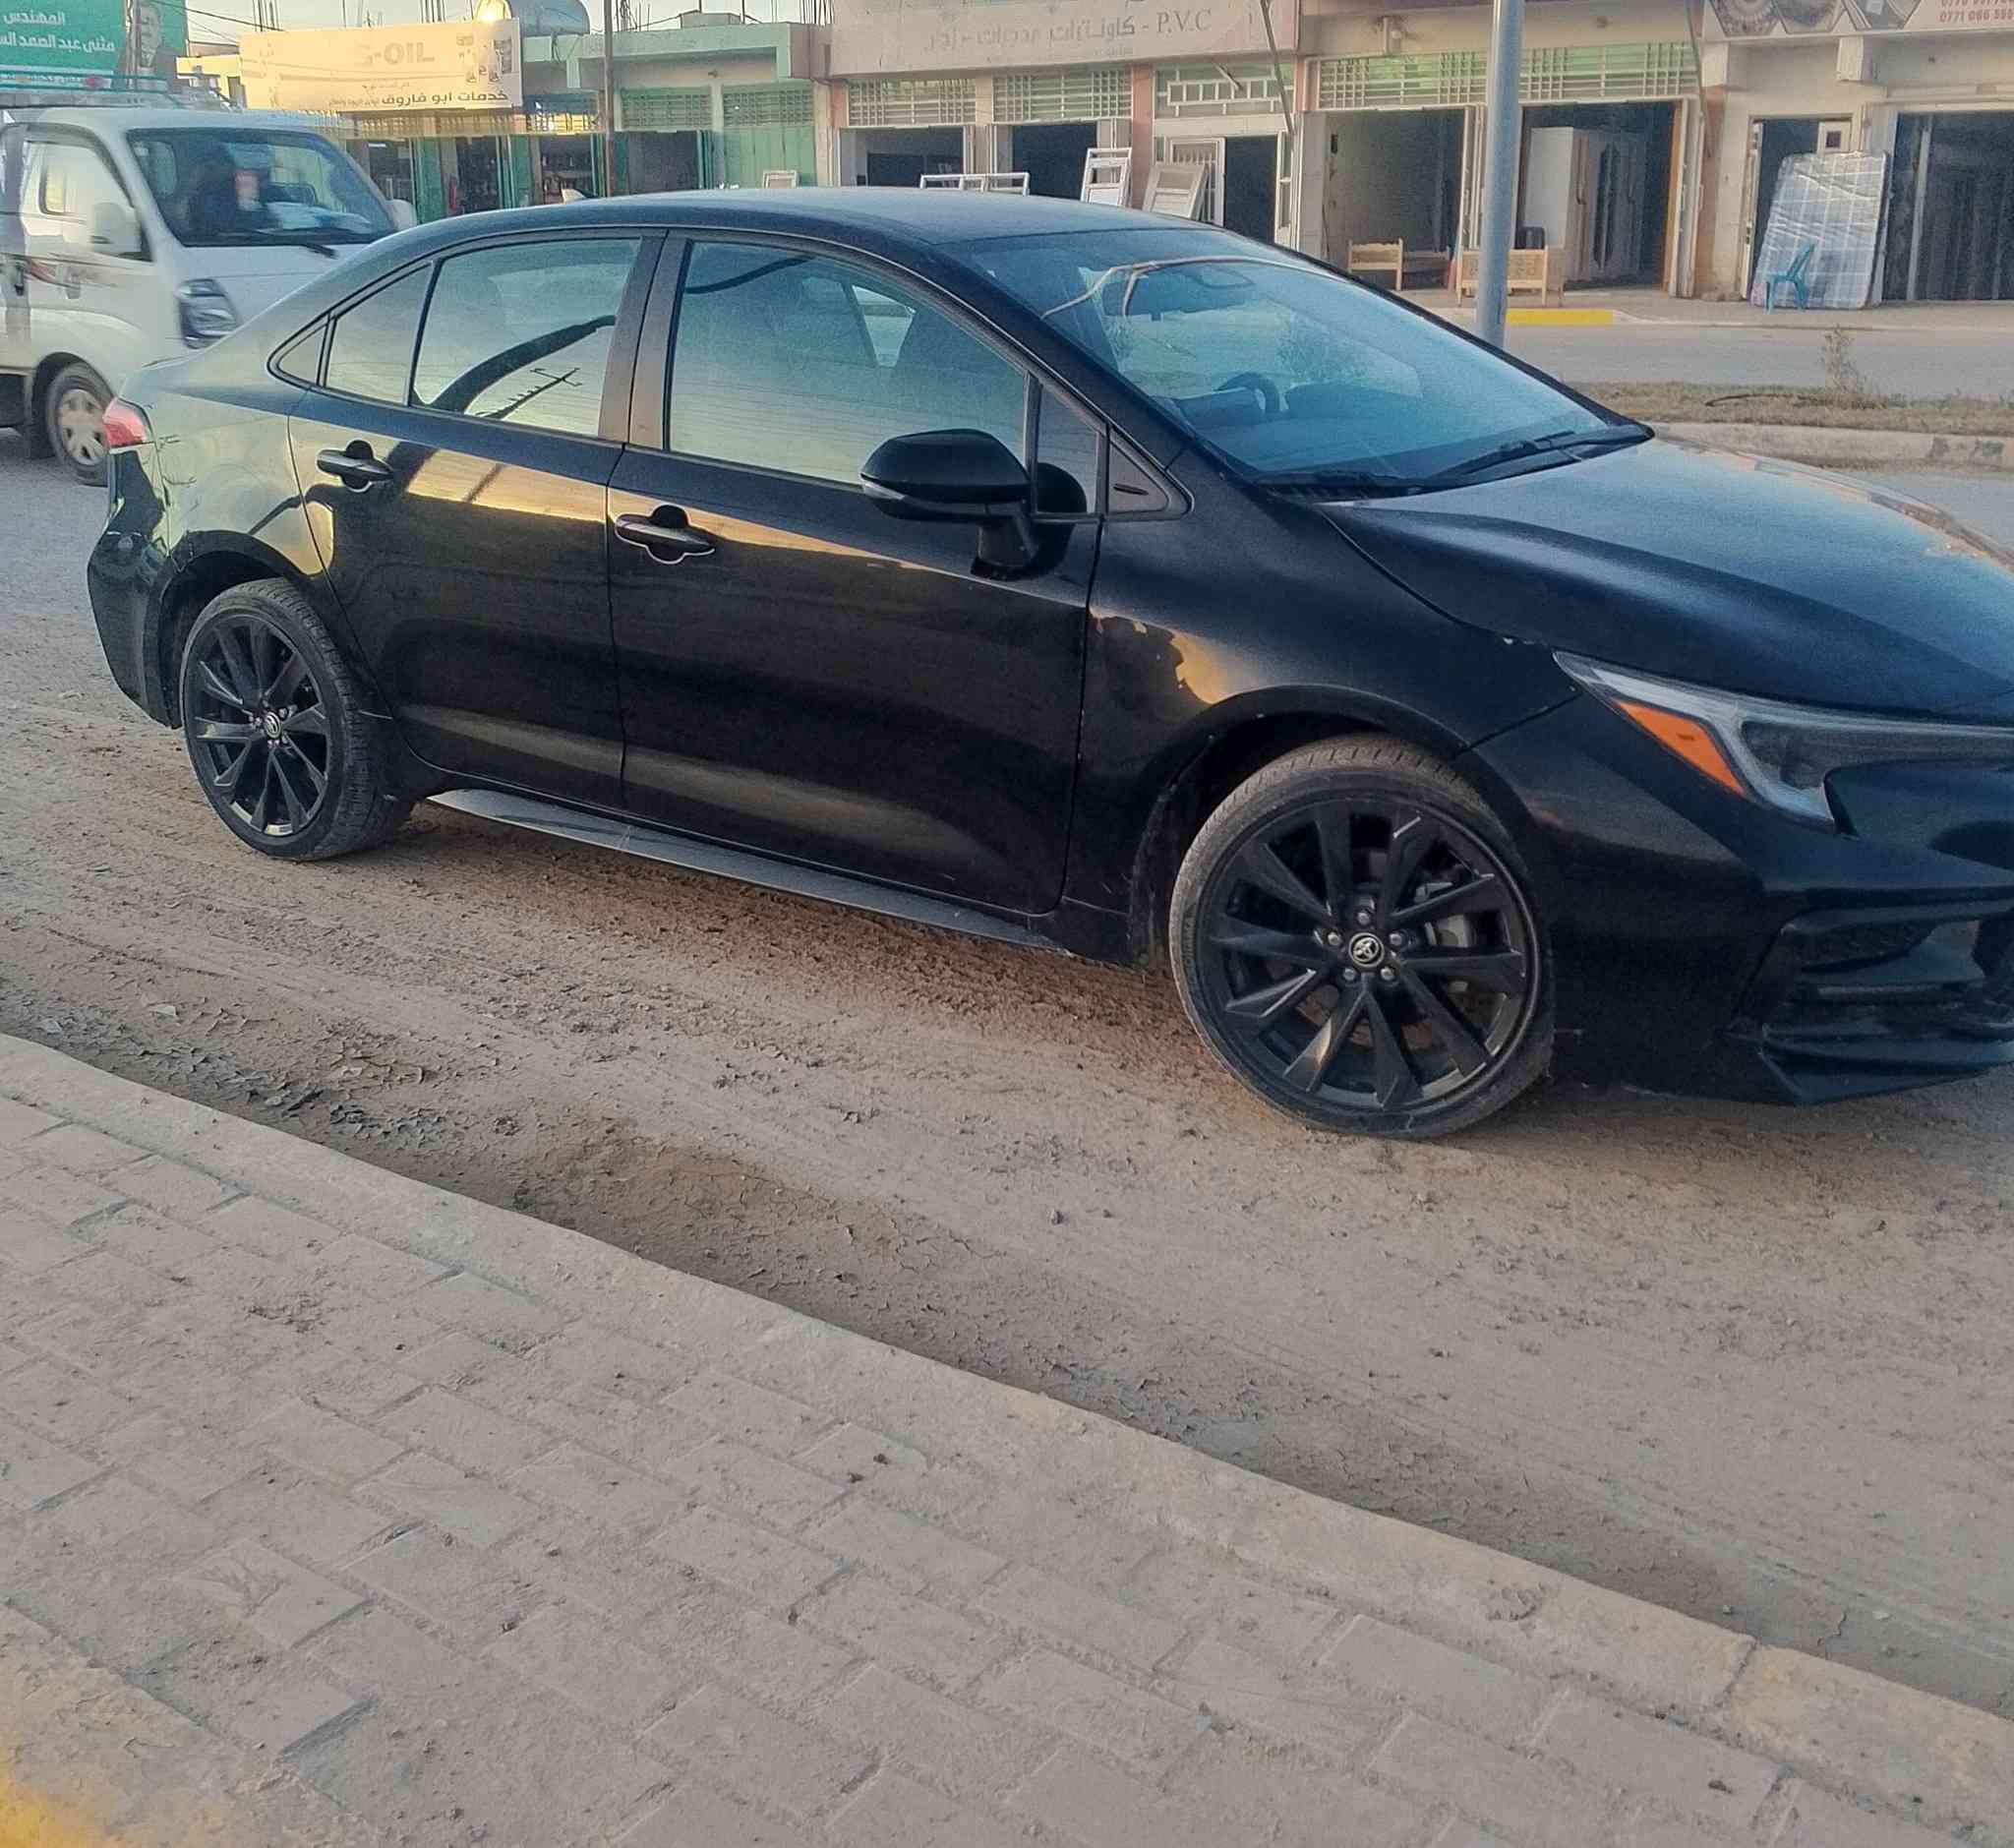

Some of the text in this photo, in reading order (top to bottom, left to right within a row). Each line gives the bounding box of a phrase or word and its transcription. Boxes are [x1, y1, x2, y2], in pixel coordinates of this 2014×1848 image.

[4, 11, 66, 26] المهندس
[19, 33, 56, 47] الصمد
[58, 36, 82, 52] عبد
[458, 89, 508, 101] خدمات
